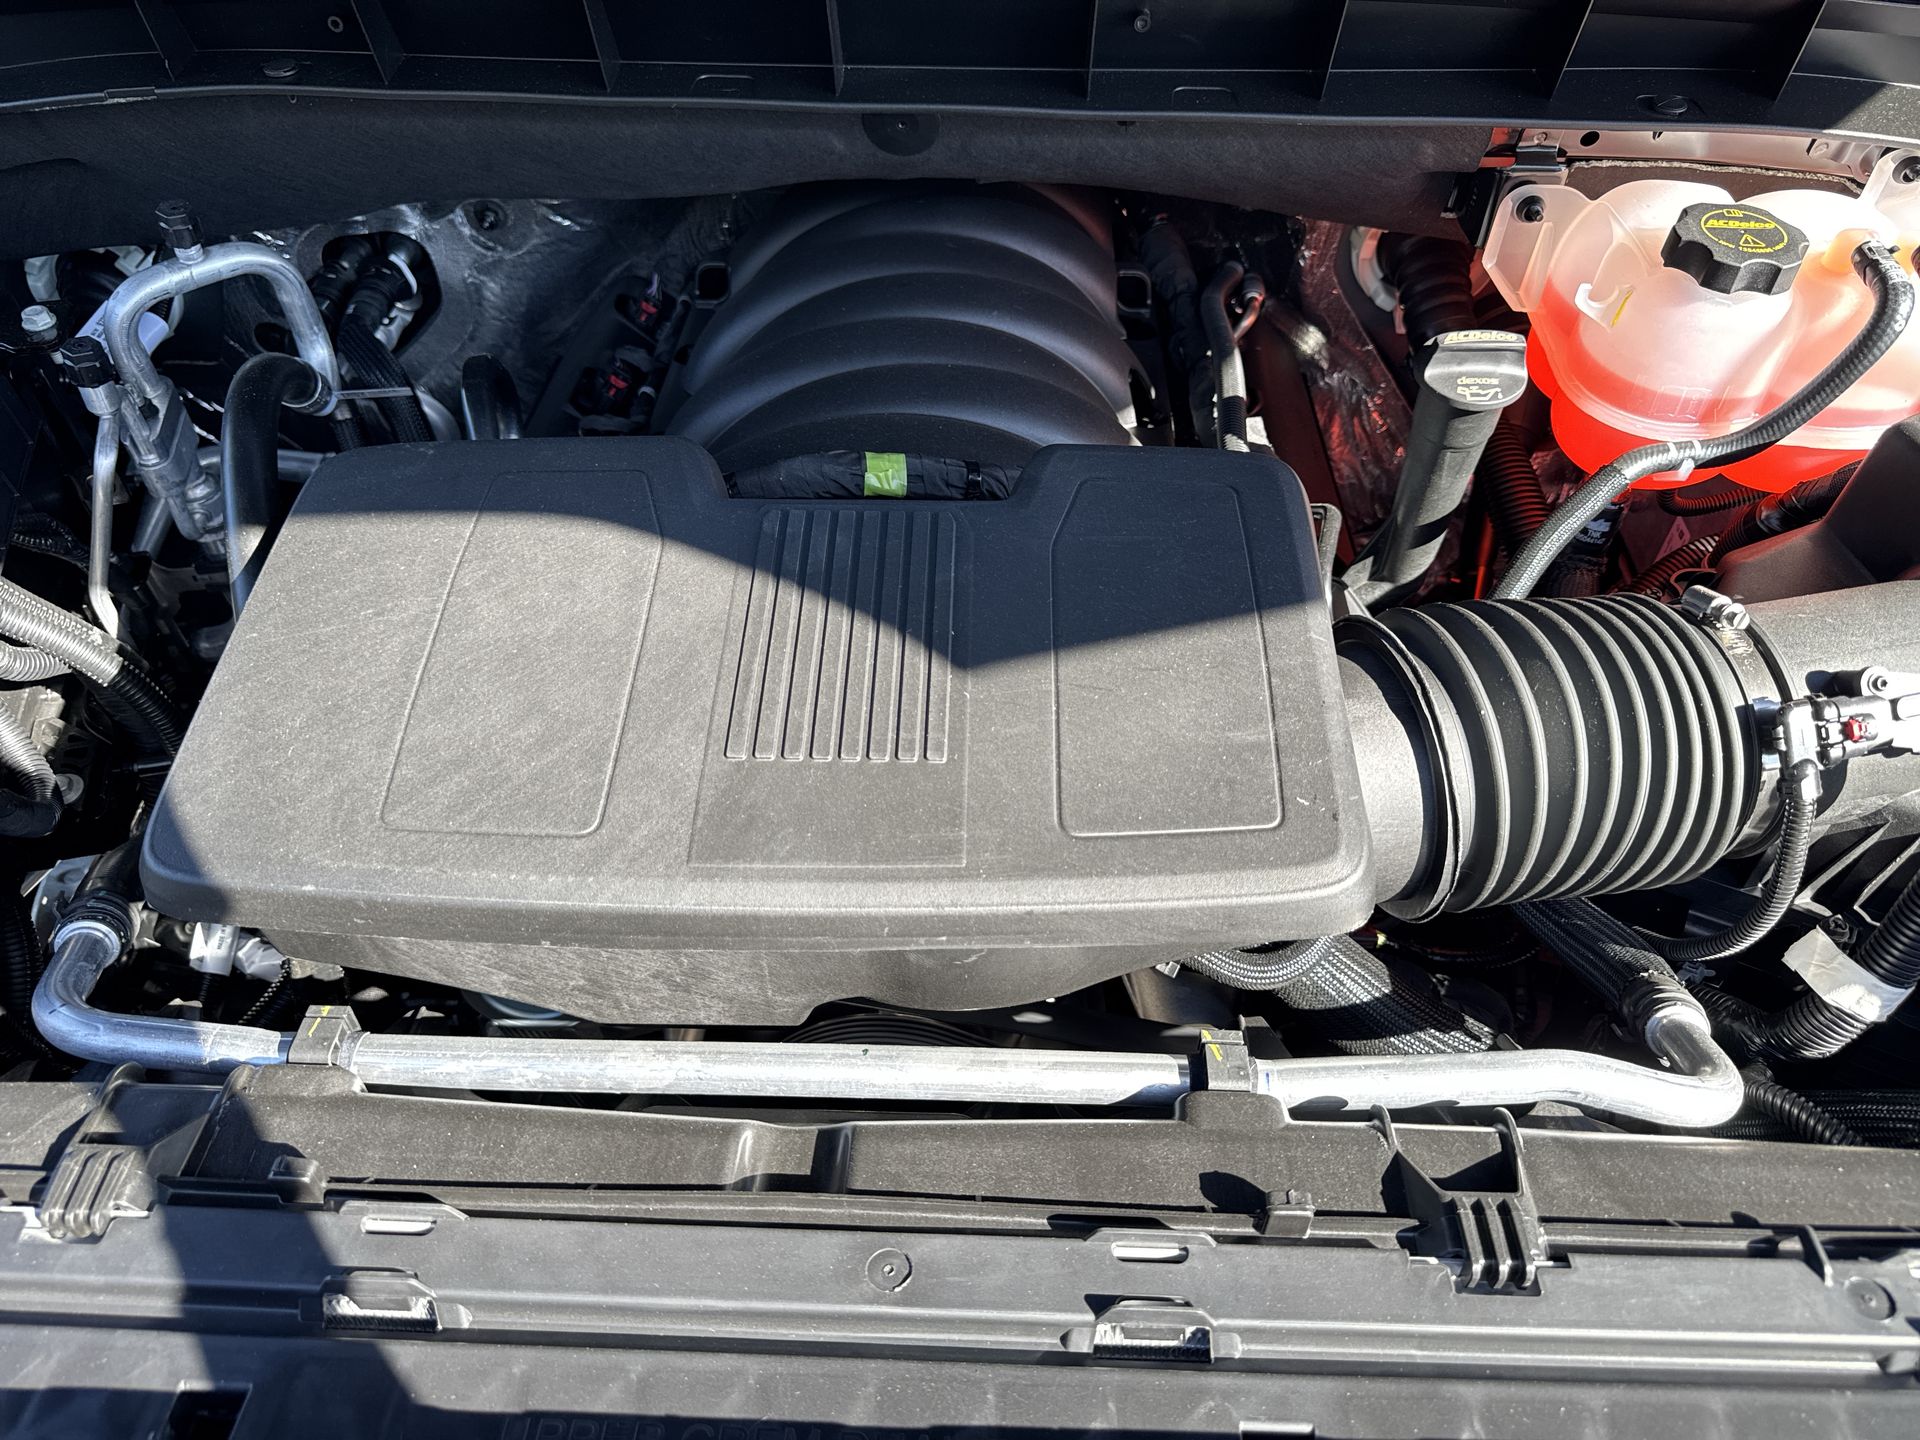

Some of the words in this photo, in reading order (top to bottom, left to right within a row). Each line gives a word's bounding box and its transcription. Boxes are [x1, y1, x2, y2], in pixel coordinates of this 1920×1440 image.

[1705, 218, 1776, 229] ACDelco
[1445, 331, 1518, 343] ACDelco
[1456, 376, 1500, 385] dexos
